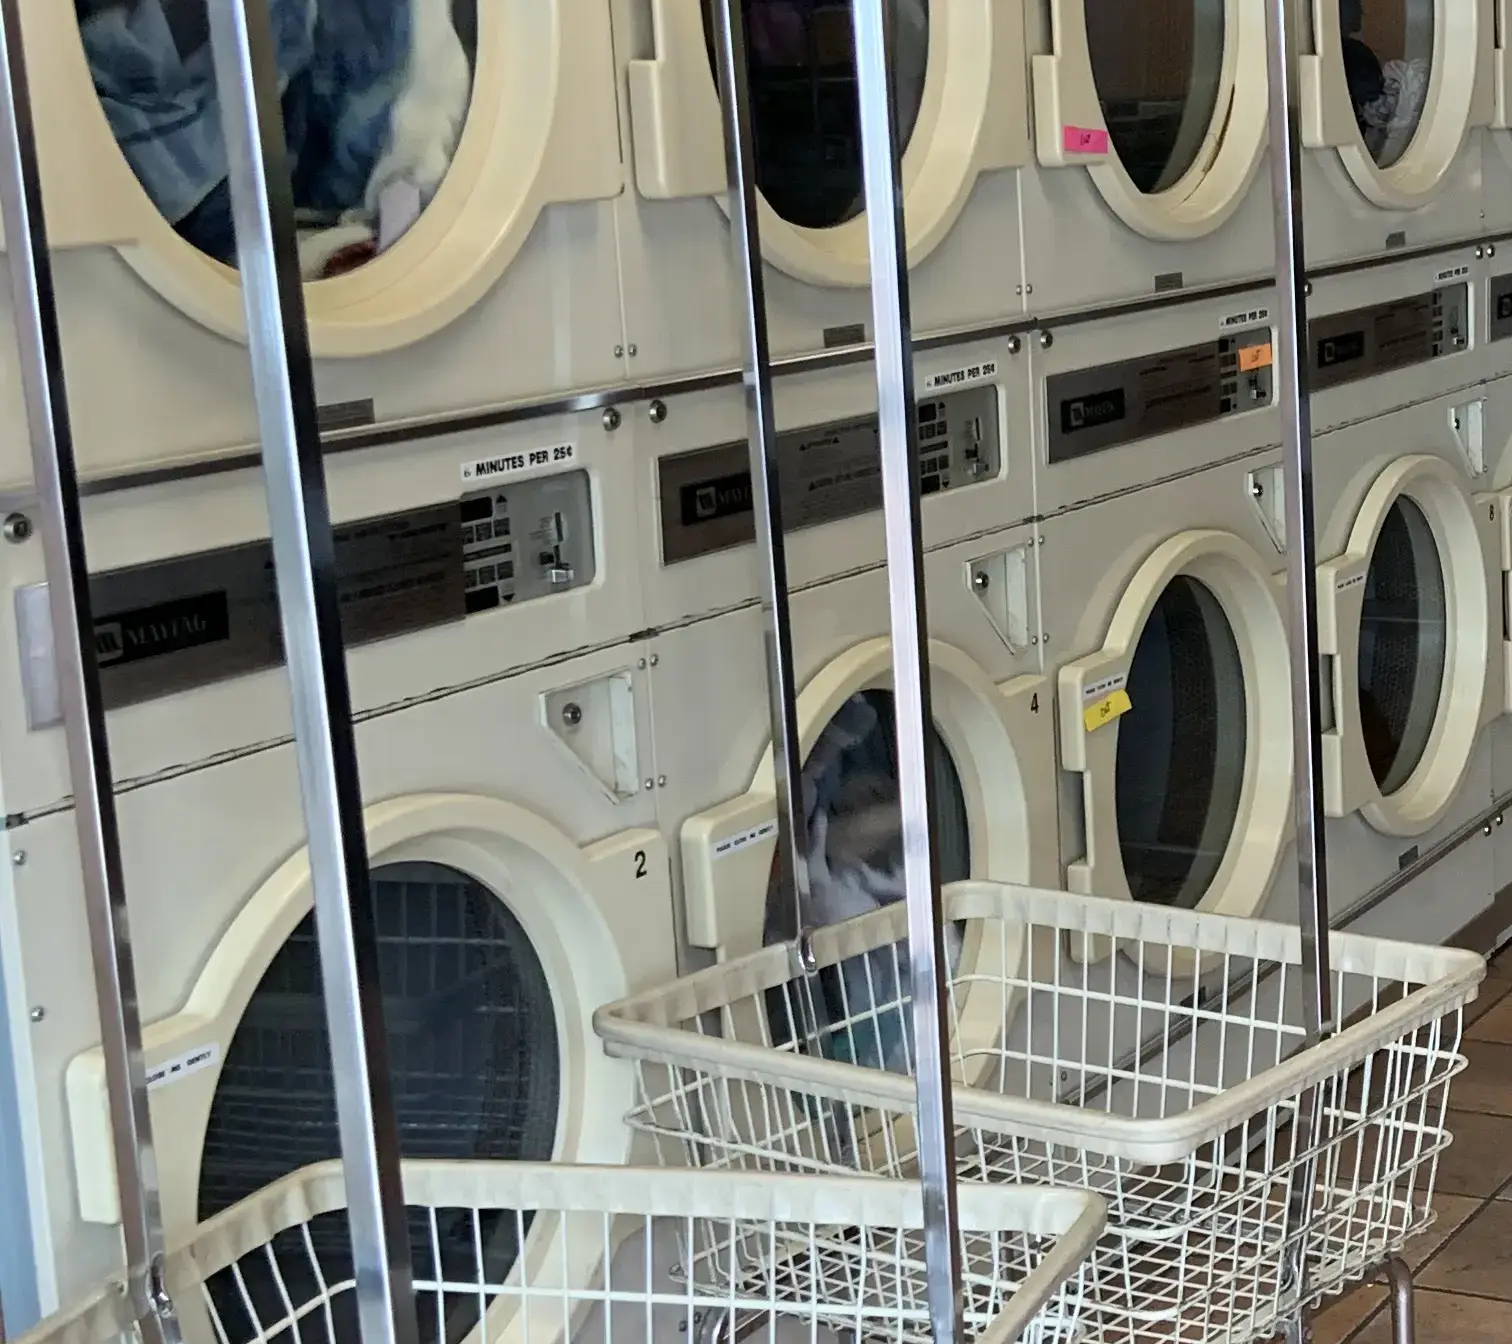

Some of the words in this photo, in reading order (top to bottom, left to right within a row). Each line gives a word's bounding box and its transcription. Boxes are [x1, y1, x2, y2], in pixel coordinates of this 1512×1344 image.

[934, 370, 965, 387] MINUTES
[967, 366, 980, 379] PER
[475, 455, 525, 477] MINUTES
[528, 450, 549, 465] PER
[553, 445, 573, 461] 25¢
[1031, 692, 1039, 714] 4
[634, 849, 648, 879] 2
